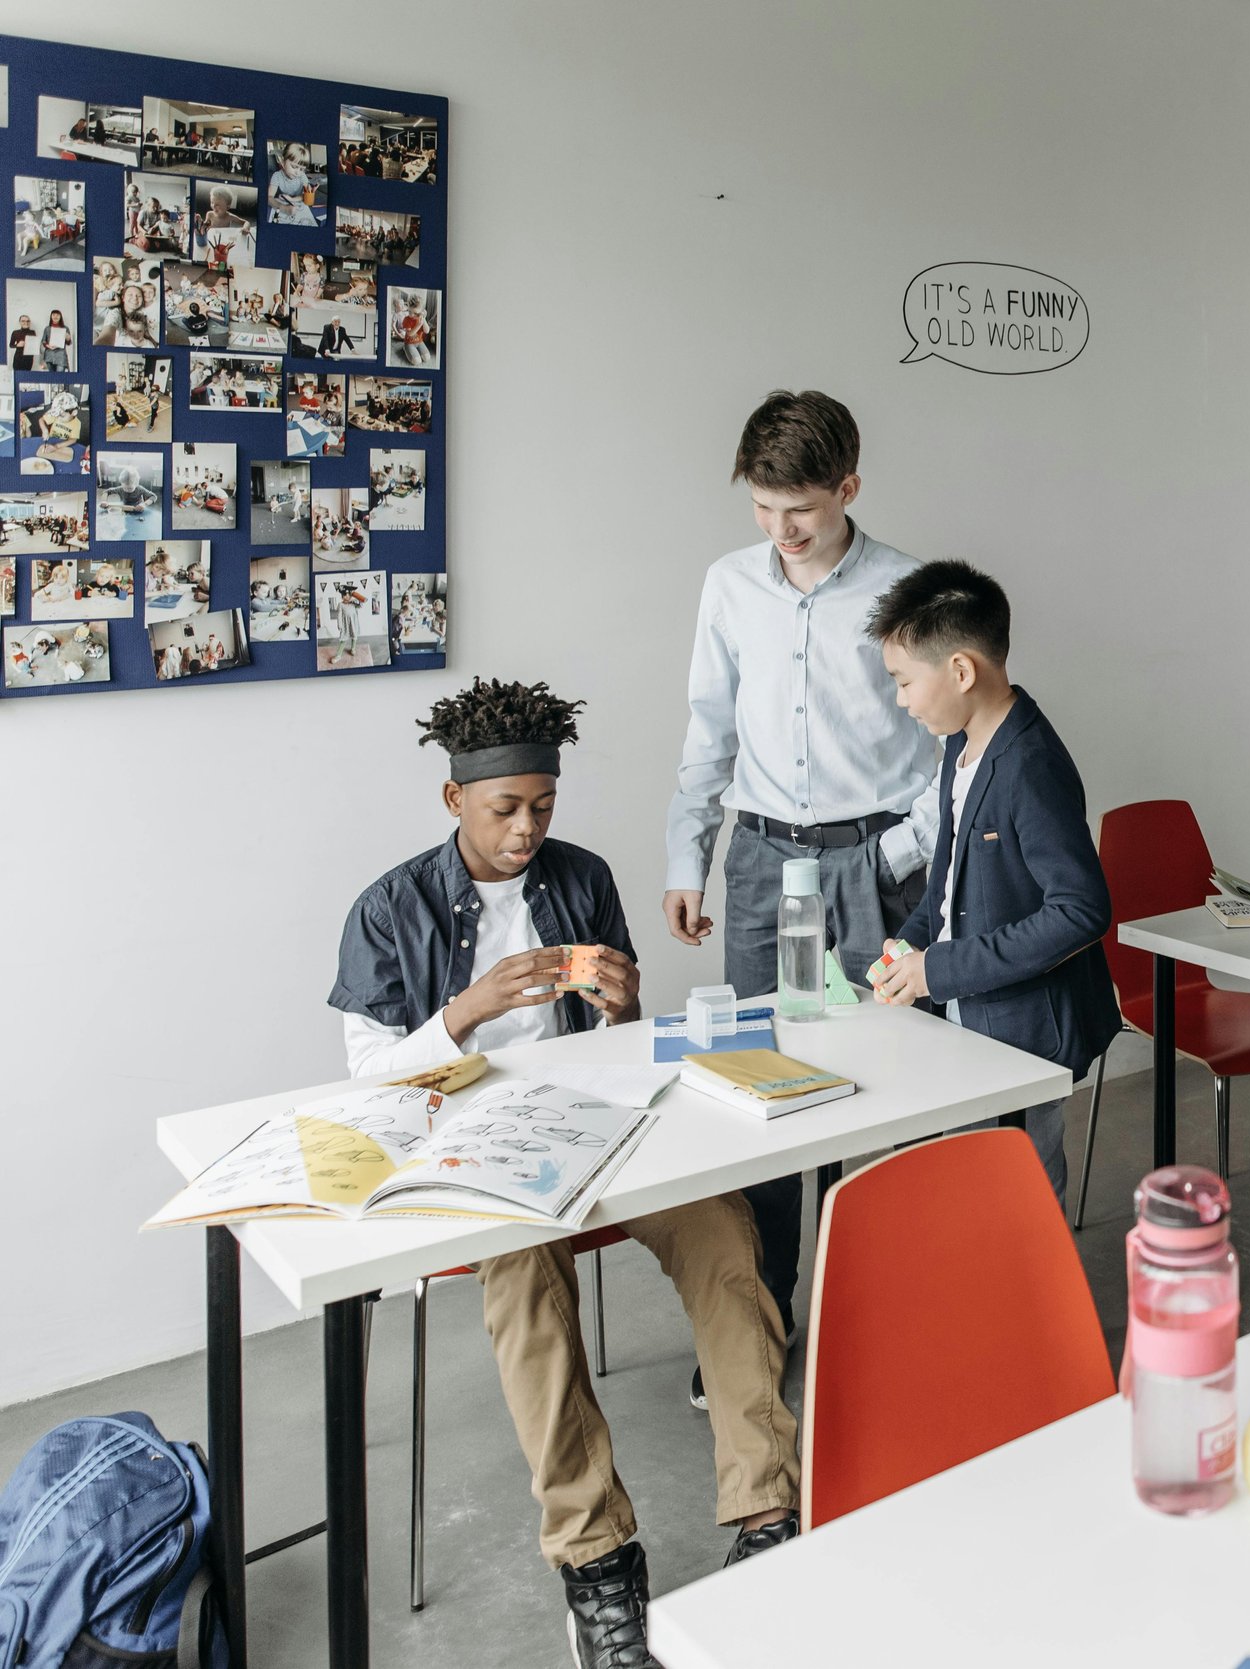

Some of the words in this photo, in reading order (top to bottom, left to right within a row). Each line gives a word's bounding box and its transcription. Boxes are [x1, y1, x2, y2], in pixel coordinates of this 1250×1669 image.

[923, 282, 971, 314] IT'S
[983, 288, 996, 314] A
[1007, 290, 1078, 322] FUNNY
[927, 317, 975, 347] OLD
